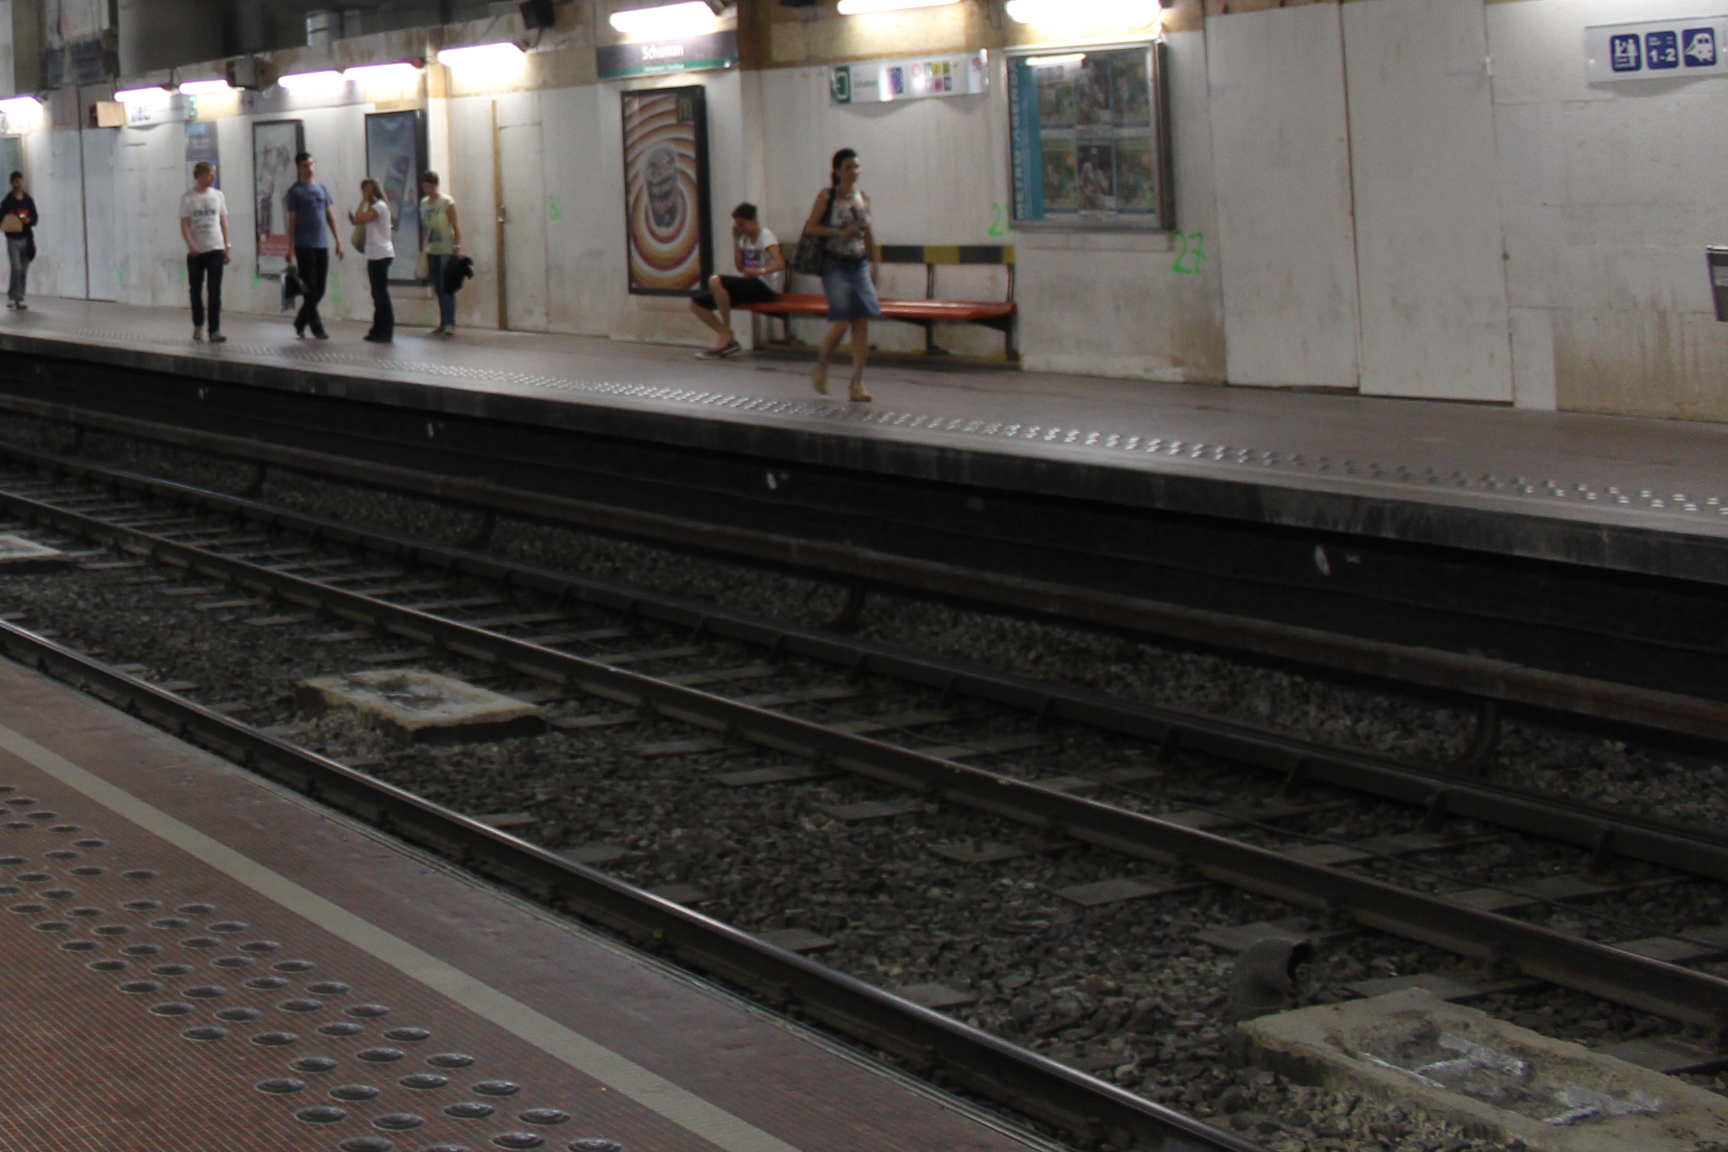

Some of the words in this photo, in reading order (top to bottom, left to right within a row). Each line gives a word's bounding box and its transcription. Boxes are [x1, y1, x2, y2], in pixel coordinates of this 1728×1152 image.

[641, 44, 685, 60] Schuman
[1648, 48, 1677, 63] 1-2
[1172, 230, 1208, 275] 27
